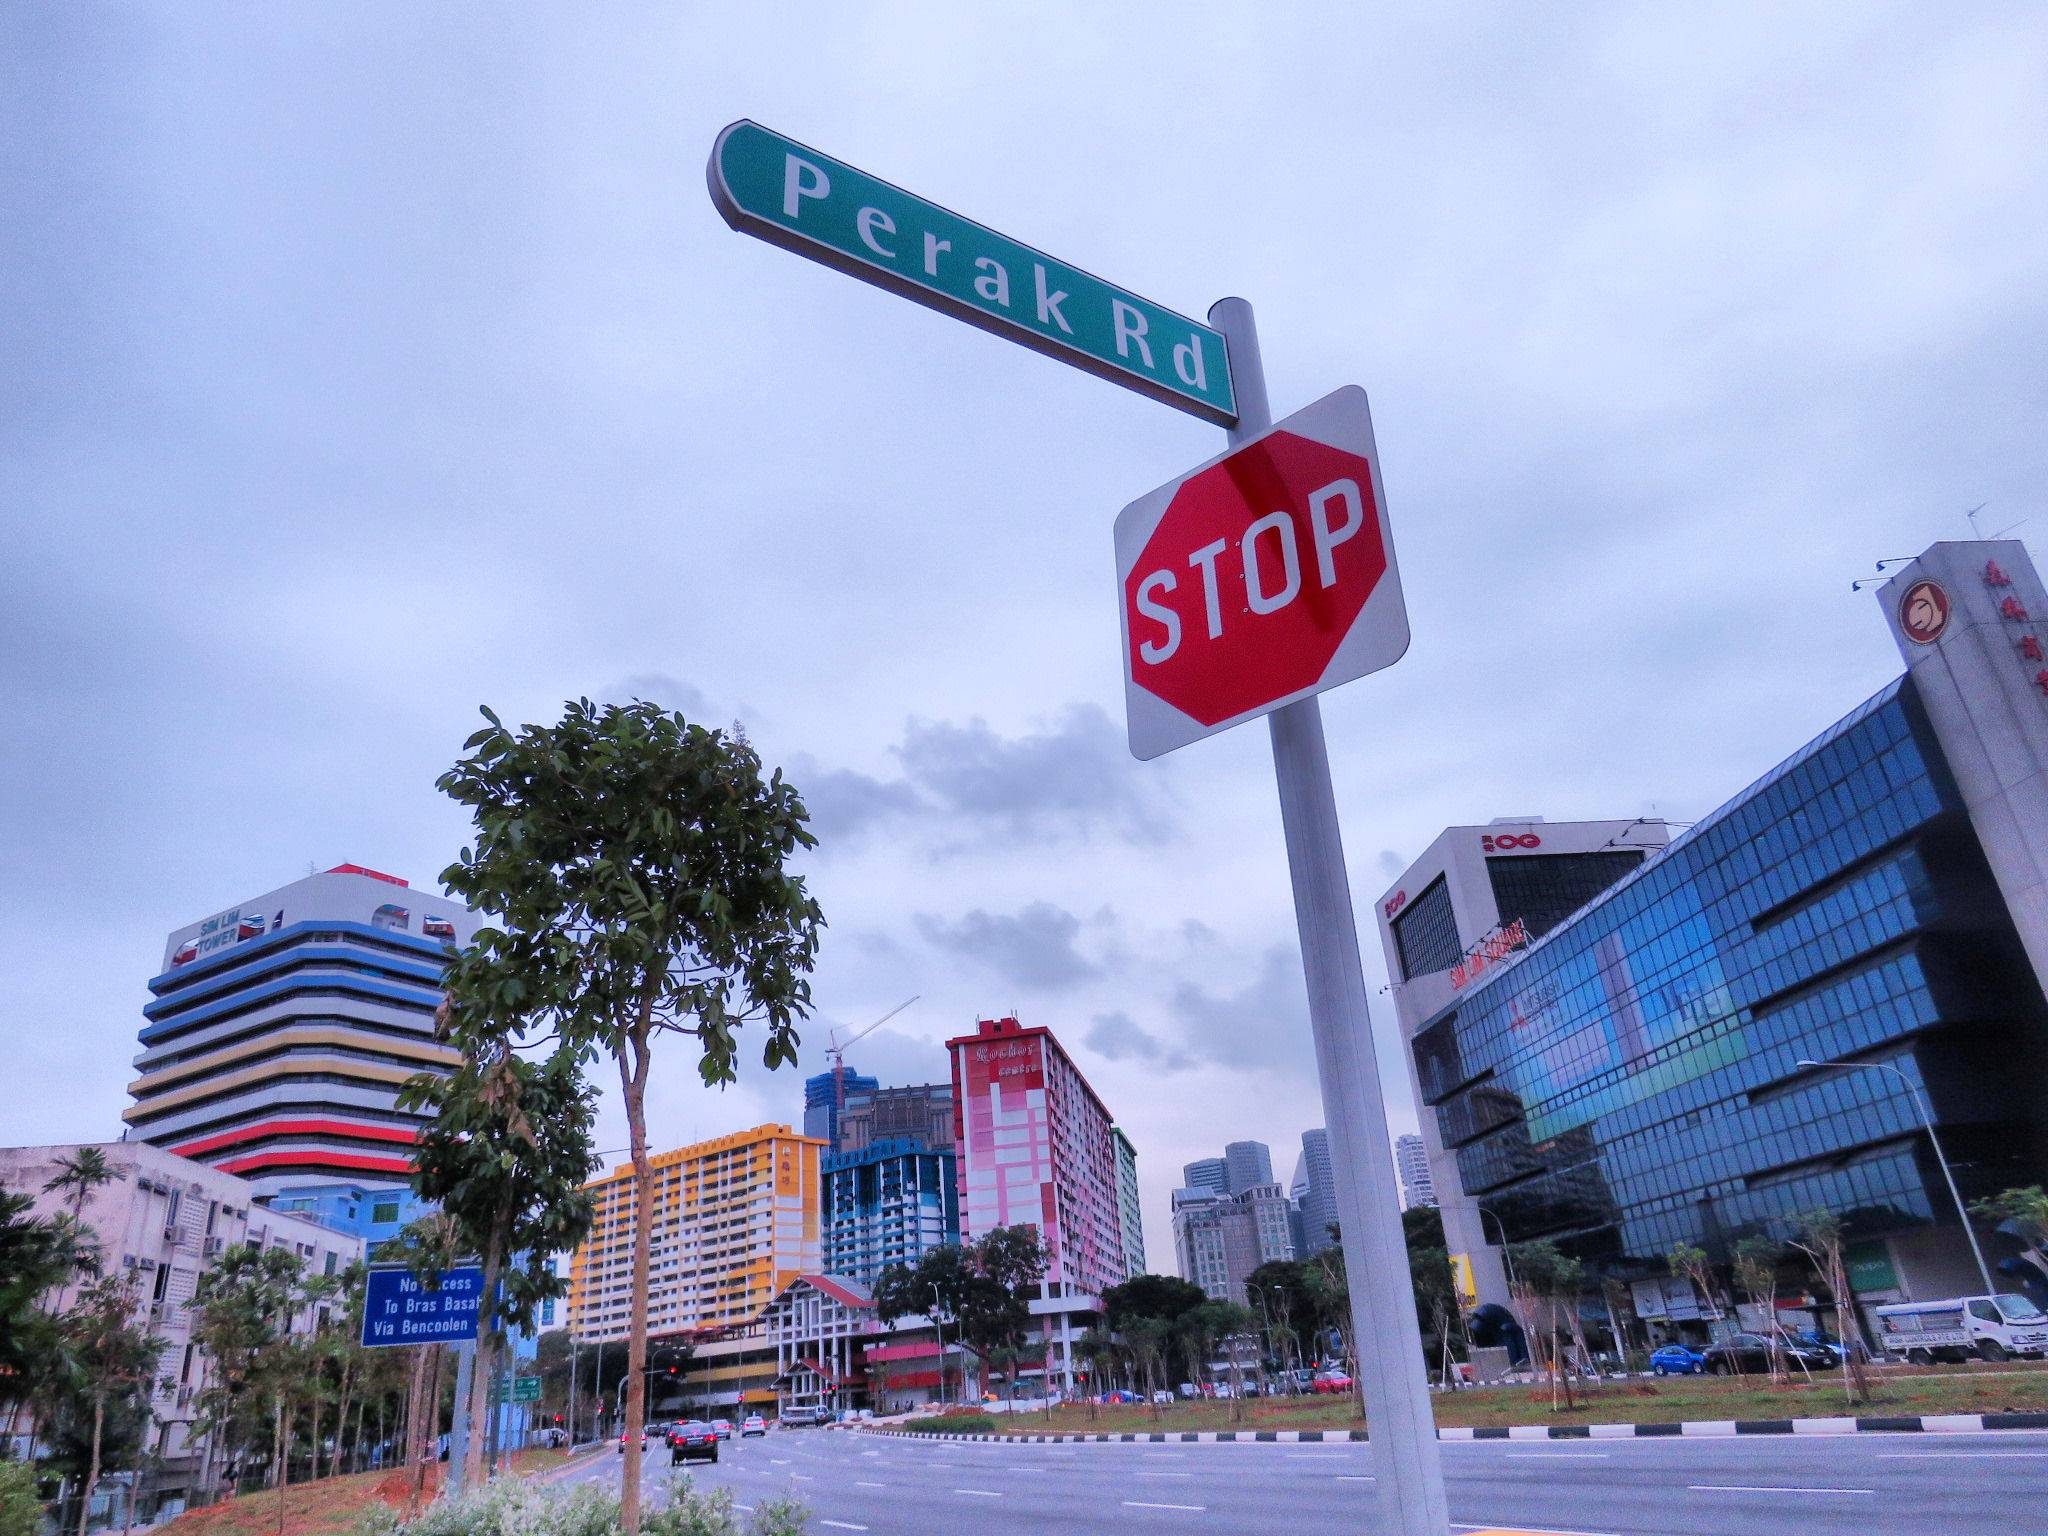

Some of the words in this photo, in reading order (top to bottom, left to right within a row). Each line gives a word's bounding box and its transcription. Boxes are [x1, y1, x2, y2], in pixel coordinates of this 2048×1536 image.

[783, 153, 1073, 335] Perak
[1110, 297, 1208, 391] Rd
[1136, 478, 1363, 665] STOP
[400, 1278, 417, 1292] No
[385, 1299, 398, 1314] To
[406, 1298, 436, 1313] Bras
[374, 1320, 394, 1336] Via
[402, 1317, 468, 1334] Bencoolen
